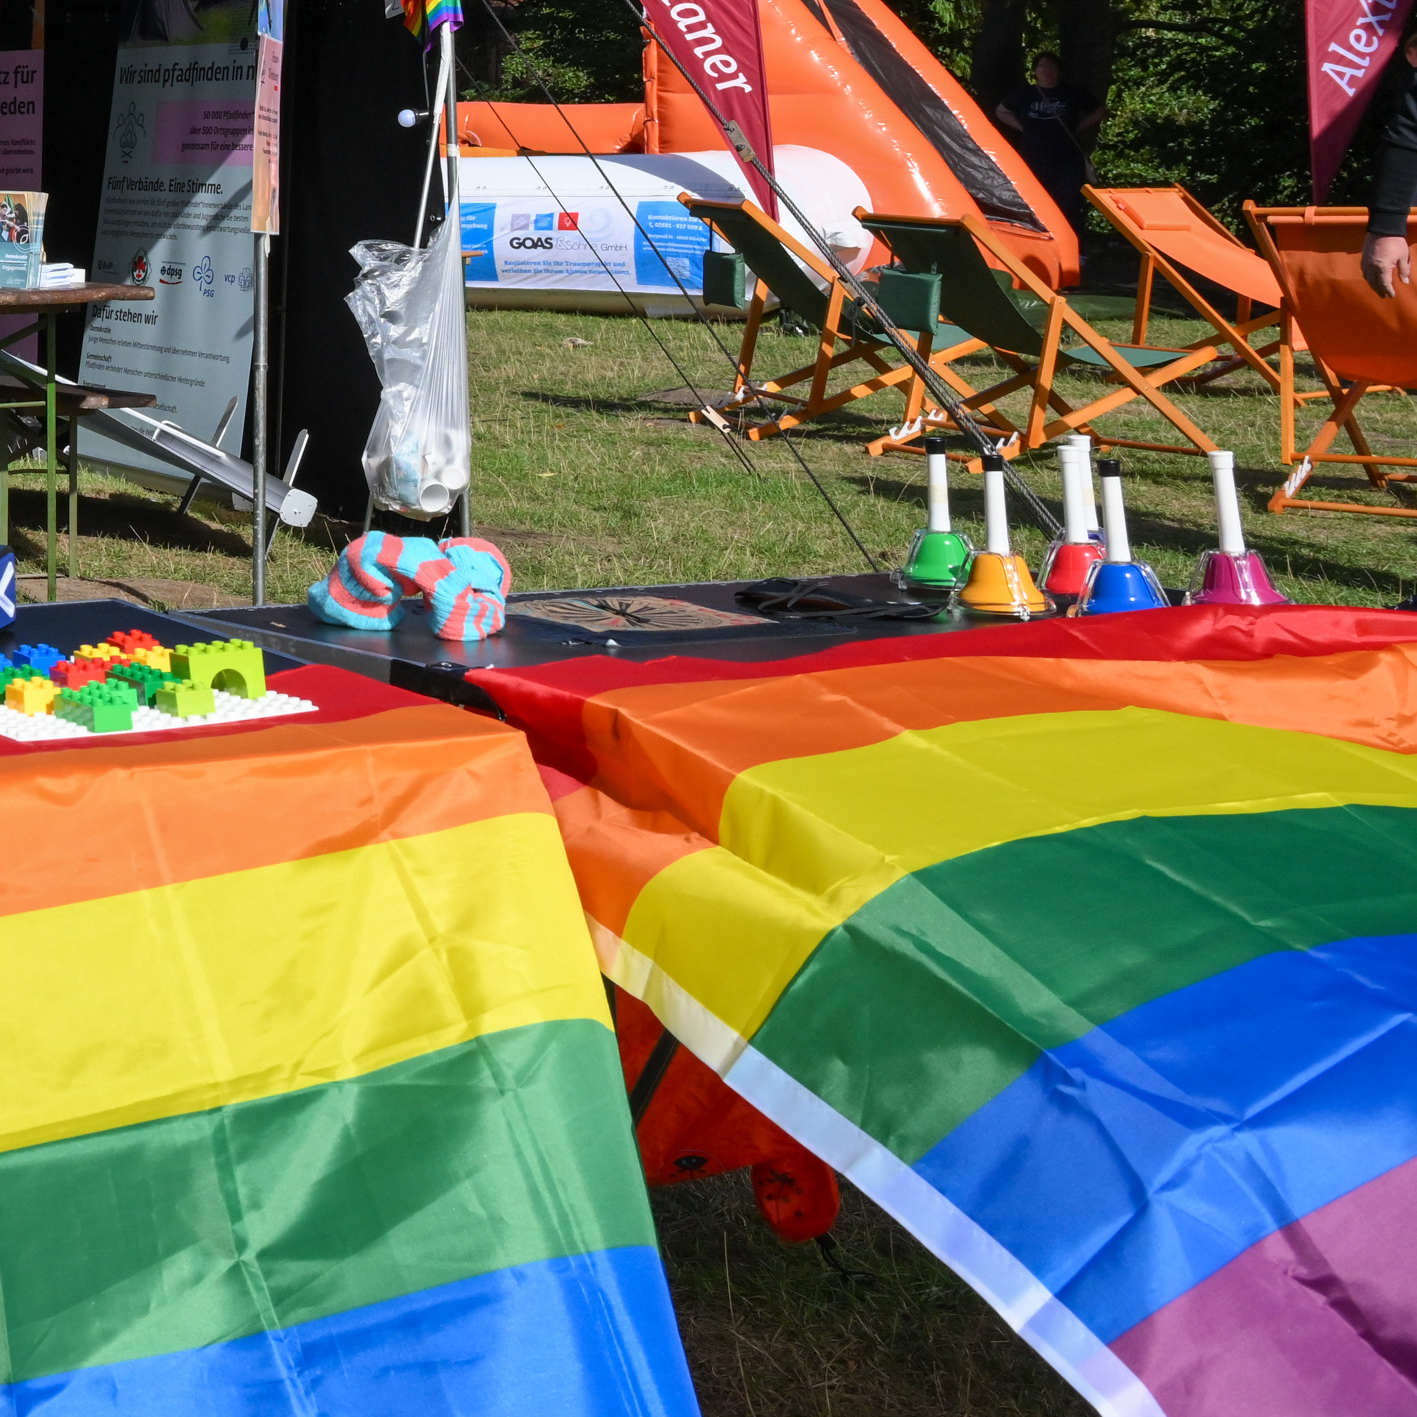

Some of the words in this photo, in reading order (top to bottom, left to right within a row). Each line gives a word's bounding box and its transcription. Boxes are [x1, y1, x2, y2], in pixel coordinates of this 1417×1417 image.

[13, 65, 37, 88] für
[119, 64, 137, 84] Wir
[138, 63, 162, 83] sind
[162, 61, 229, 88] pfadfinden
[232, 59, 241, 80] in
[203, 110, 210, 119] 50
[211, 110, 222, 119] 000
[202, 126, 212, 134] 500
[214, 126, 247, 137] Ortsgruppen
[210, 141, 220, 152] für
[220, 141, 231, 150] eine
[107, 176, 127, 196] Fünf
[127, 177, 166, 192] Verbände.
[168, 179, 186, 193] Eine
[186, 178, 223, 194] Stimme.
[510, 237, 553, 249] GOAS
[601, 243, 628, 252] GmbH
[167, 265, 183, 279] dpsg
[224, 274, 236, 284] vcp
[203, 289, 214, 297] PSG
[92, 304, 114, 322] Dafür
[114, 307, 142, 324] stehen
[144, 310, 158, 325] wir
[86, 352, 112, 363] Gemeinschaft
